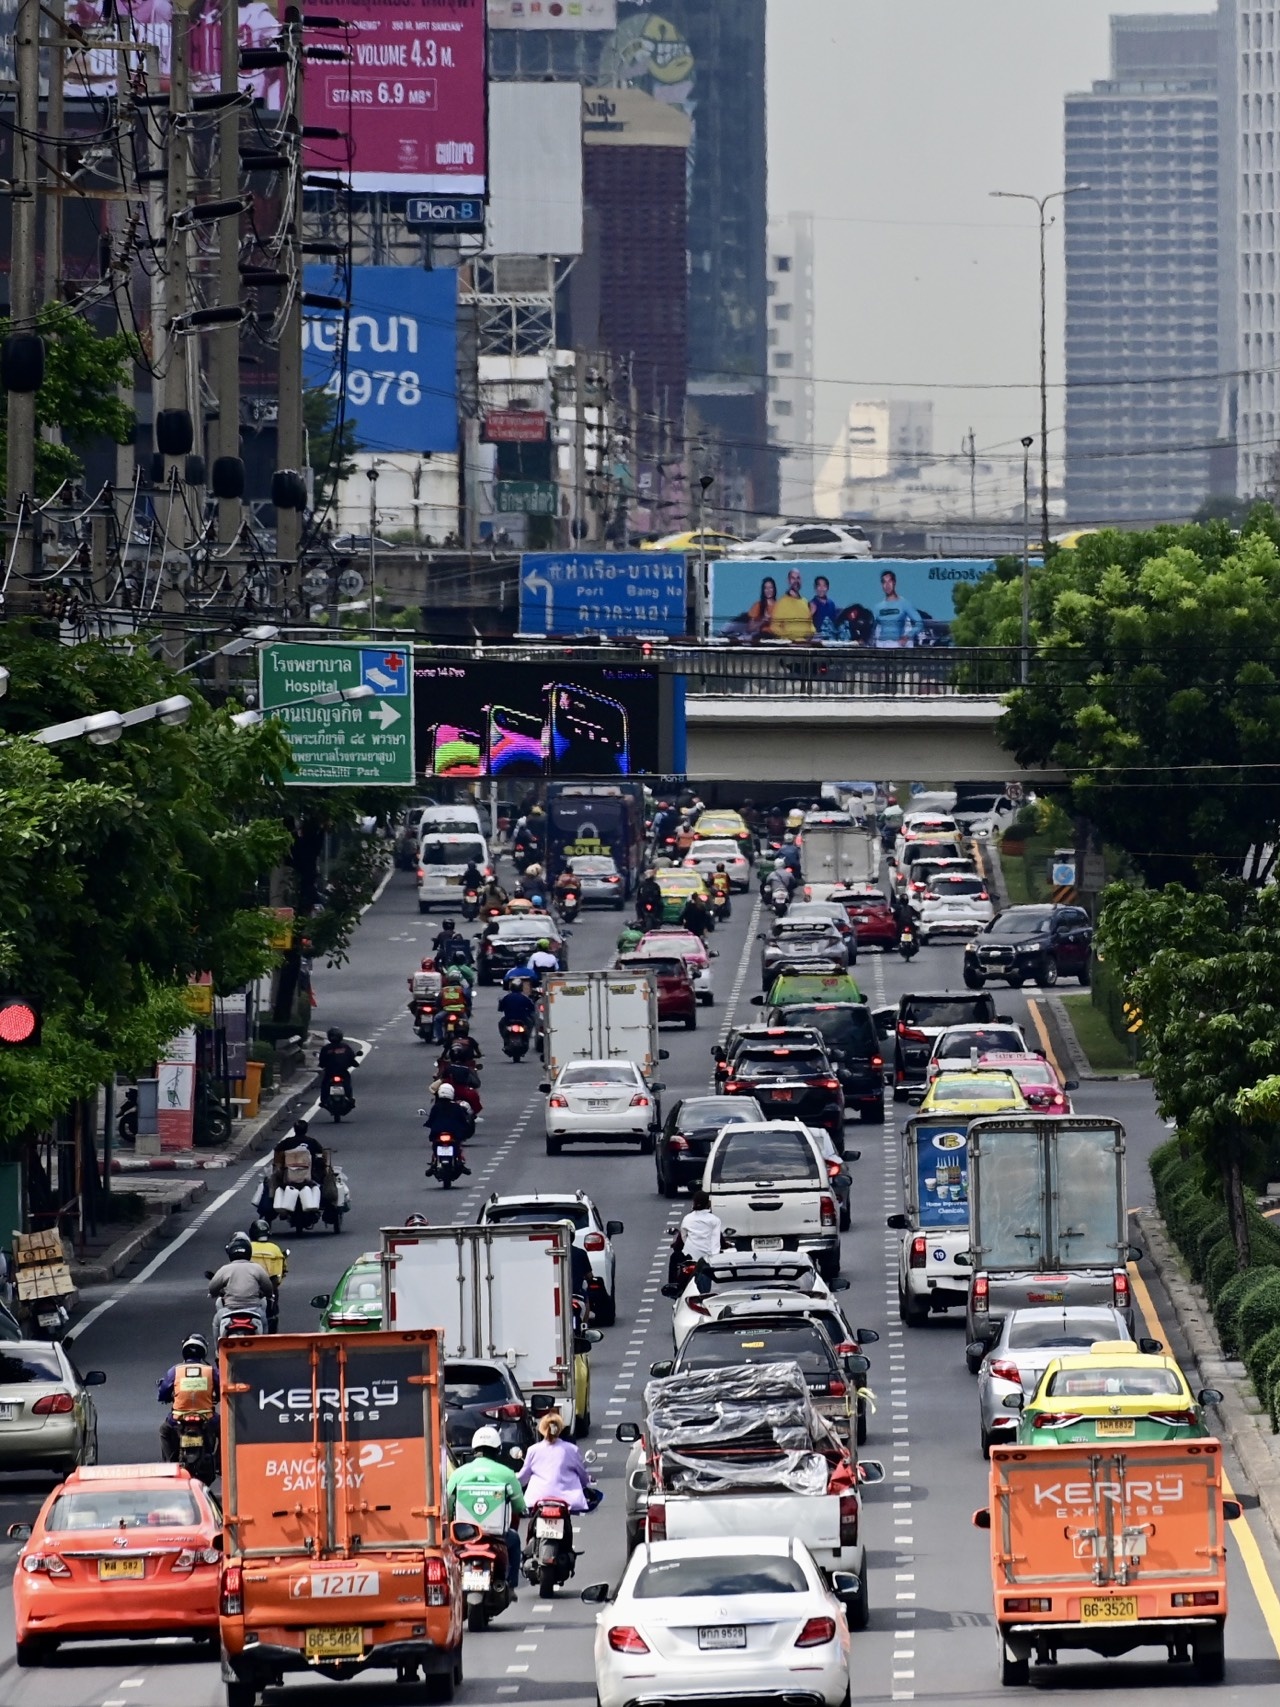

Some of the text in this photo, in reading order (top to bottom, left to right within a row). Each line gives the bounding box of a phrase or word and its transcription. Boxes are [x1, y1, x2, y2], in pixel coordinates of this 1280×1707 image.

[357, 44, 408, 67] VOLUME
[411, 38, 437, 67] 4.3
[332, 88, 373, 103] STARTS
[377, 82, 404, 104] 6.9
[577, 585, 683, 599] Port Bang Na
[270, 651, 352, 672] โรงพยาบาล
[285, 679, 338, 694] Hospital
[357, 767, 380, 777] Park
[935, 1251, 944, 1259] 19
[259, 1385, 398, 1410] KERRY
[279, 1411, 380, 1423] EXPRESS
[1034, 1479, 1183, 1505] KERRY
[1056, 1505, 1164, 1519] EXPESS
[320, 1574, 370, 1595] 1217
[1083, 1602, 1134, 1617] 66-3520
[308, 1631, 360, 1648] 66-5484
